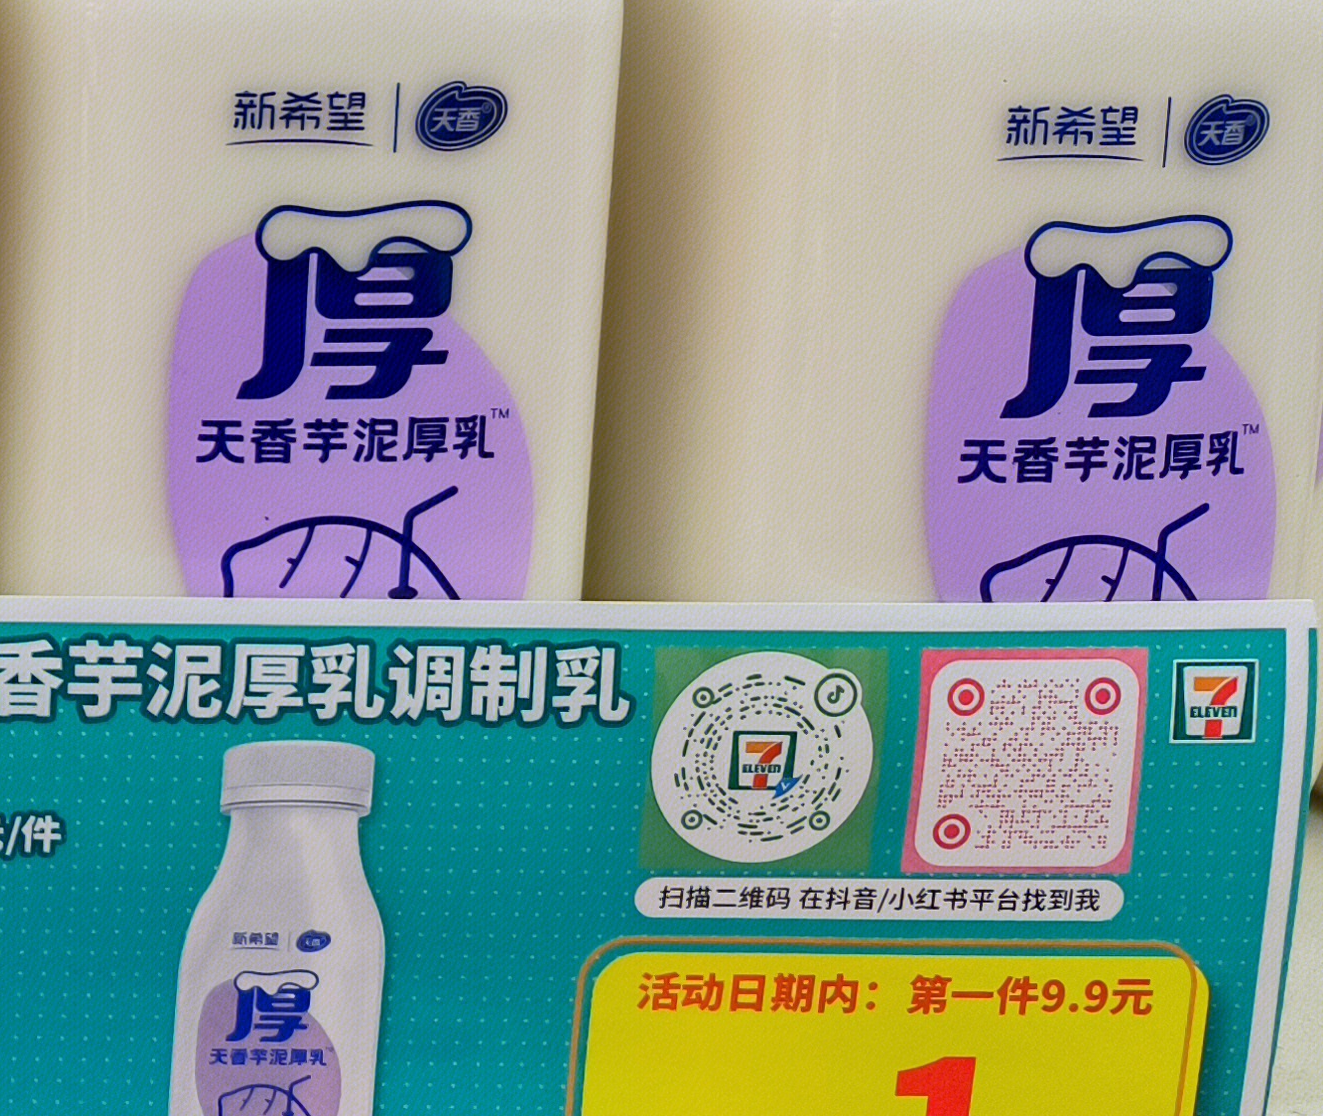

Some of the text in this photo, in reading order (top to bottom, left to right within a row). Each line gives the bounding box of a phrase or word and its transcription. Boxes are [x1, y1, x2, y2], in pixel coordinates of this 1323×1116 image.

[233, 90, 366, 132] 新希望
[1005, 105, 1139, 146] 新希望
[236, 200, 472, 400] 厚
[1000, 215, 1233, 419] 厚
[195, 414, 495, 464] 天香芋泥厚乳
[957, 431, 1245, 484] 天香芋泥厚乳
[658, 886, 1101, 914] 扫描二维码 在抖音/小红书平台找到我
[225, 969, 320, 1043] 厚
